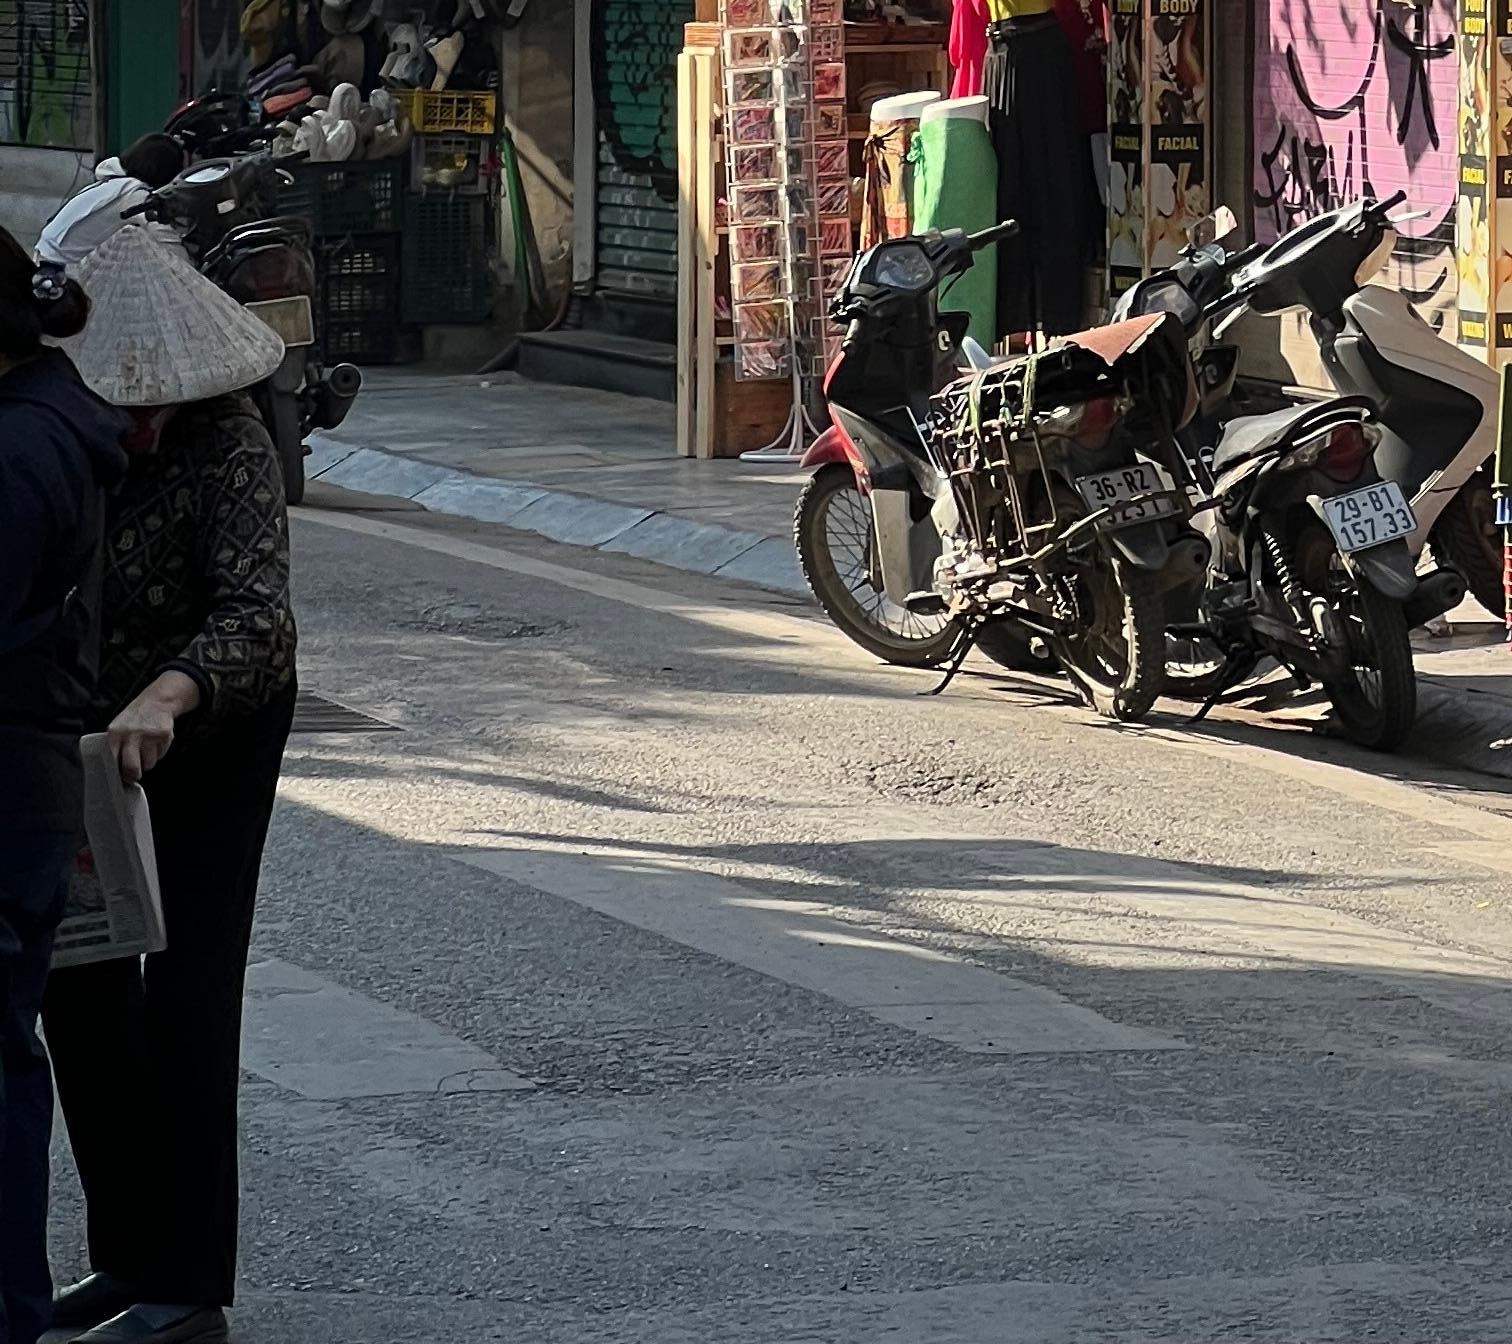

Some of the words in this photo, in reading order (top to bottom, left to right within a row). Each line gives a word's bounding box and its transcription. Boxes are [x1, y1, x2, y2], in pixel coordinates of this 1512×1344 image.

[1159, 0, 1199, 13] BODY
[1158, 135, 1200, 151] FACIAL
[1089, 468, 1151, 500] 36-R2
[1334, 487, 1395, 523] 29-B1
[1340, 508, 1412, 548] 157.33
